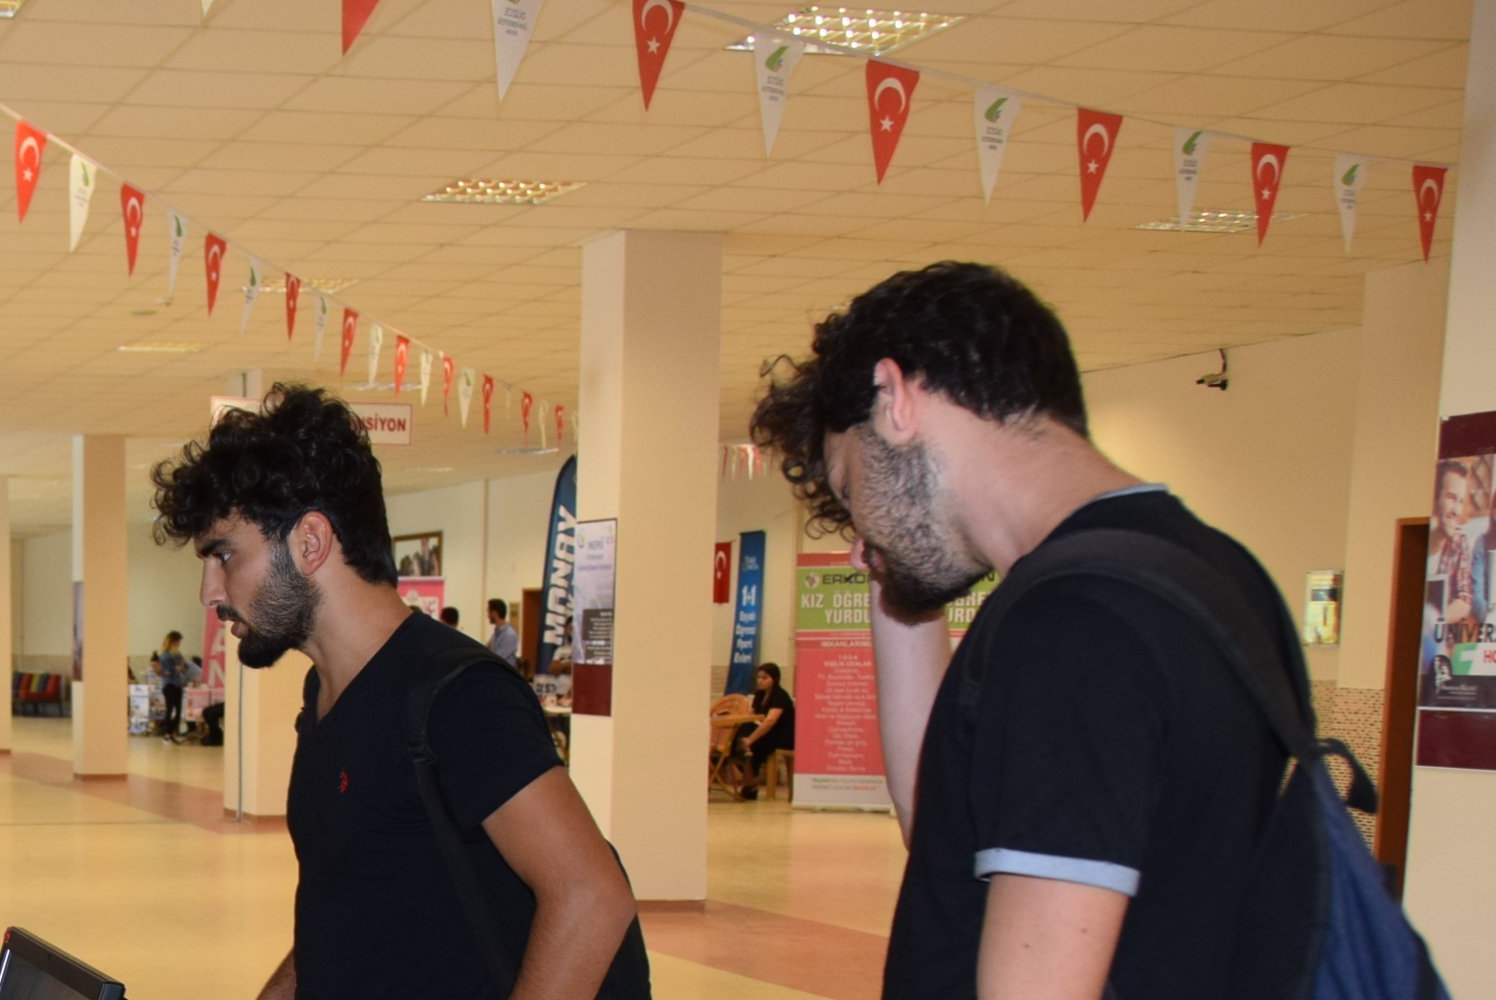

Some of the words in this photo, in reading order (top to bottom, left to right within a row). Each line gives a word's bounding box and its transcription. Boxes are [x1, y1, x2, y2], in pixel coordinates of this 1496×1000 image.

[822, 573, 870, 585] ERKO
[801, 593, 824, 609] KIZ
[1434, 617, 1496, 643] ÜNİVER
